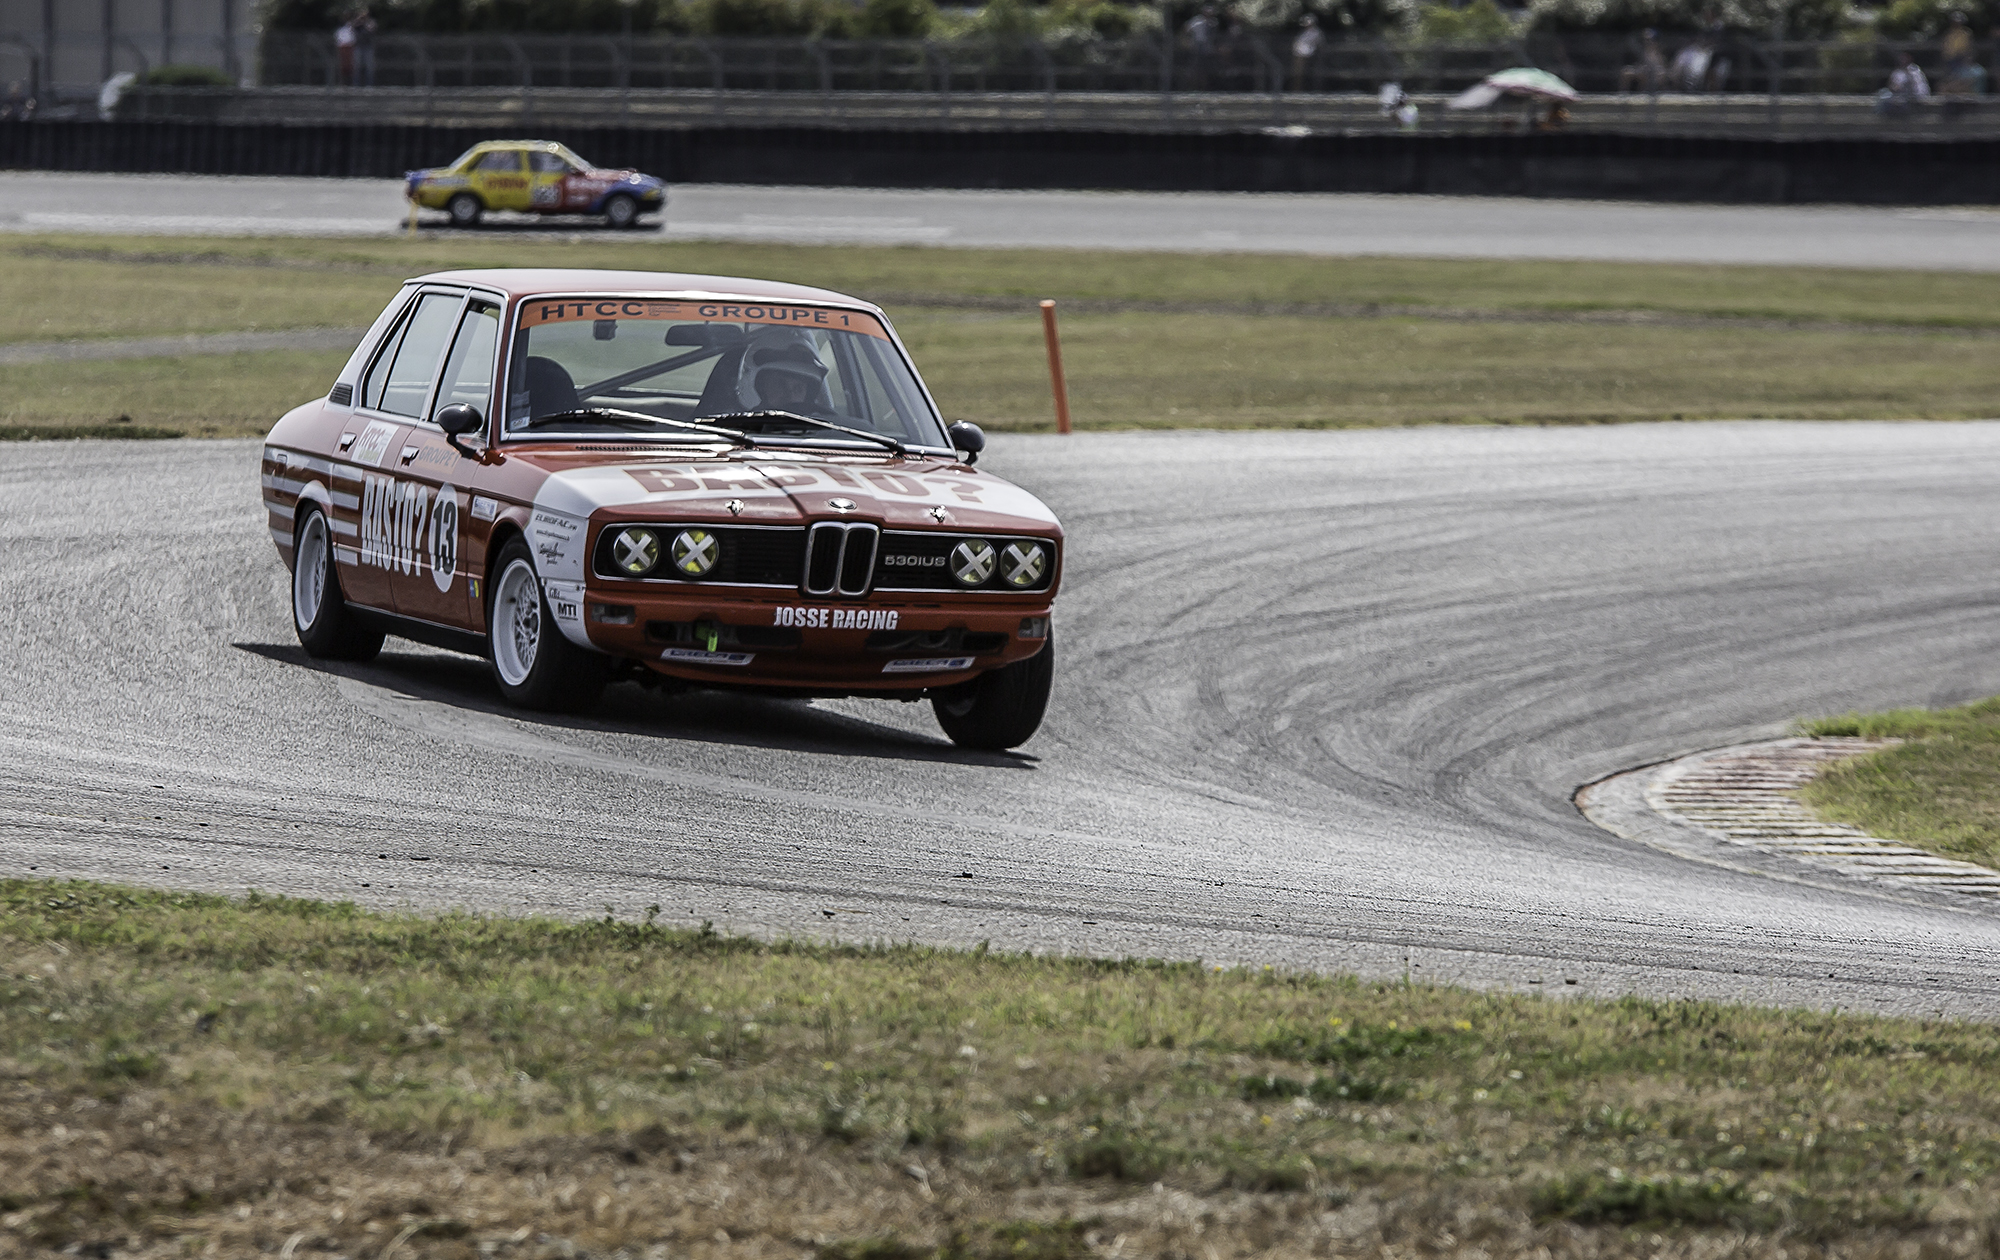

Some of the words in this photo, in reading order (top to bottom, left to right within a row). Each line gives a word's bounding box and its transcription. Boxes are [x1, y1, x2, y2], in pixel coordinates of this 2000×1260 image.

[541, 302, 644, 320] HTCC
[699, 304, 829, 324] GROUPE
[840, 314, 849, 326] 1
[418, 445, 455, 467] GROUPE
[451, 453, 460, 468] 1
[433, 500, 456, 575] 13
[557, 601, 577, 617] MTI
[774, 606, 830, 628] JOSSE
[832, 609, 899, 631] RACING
